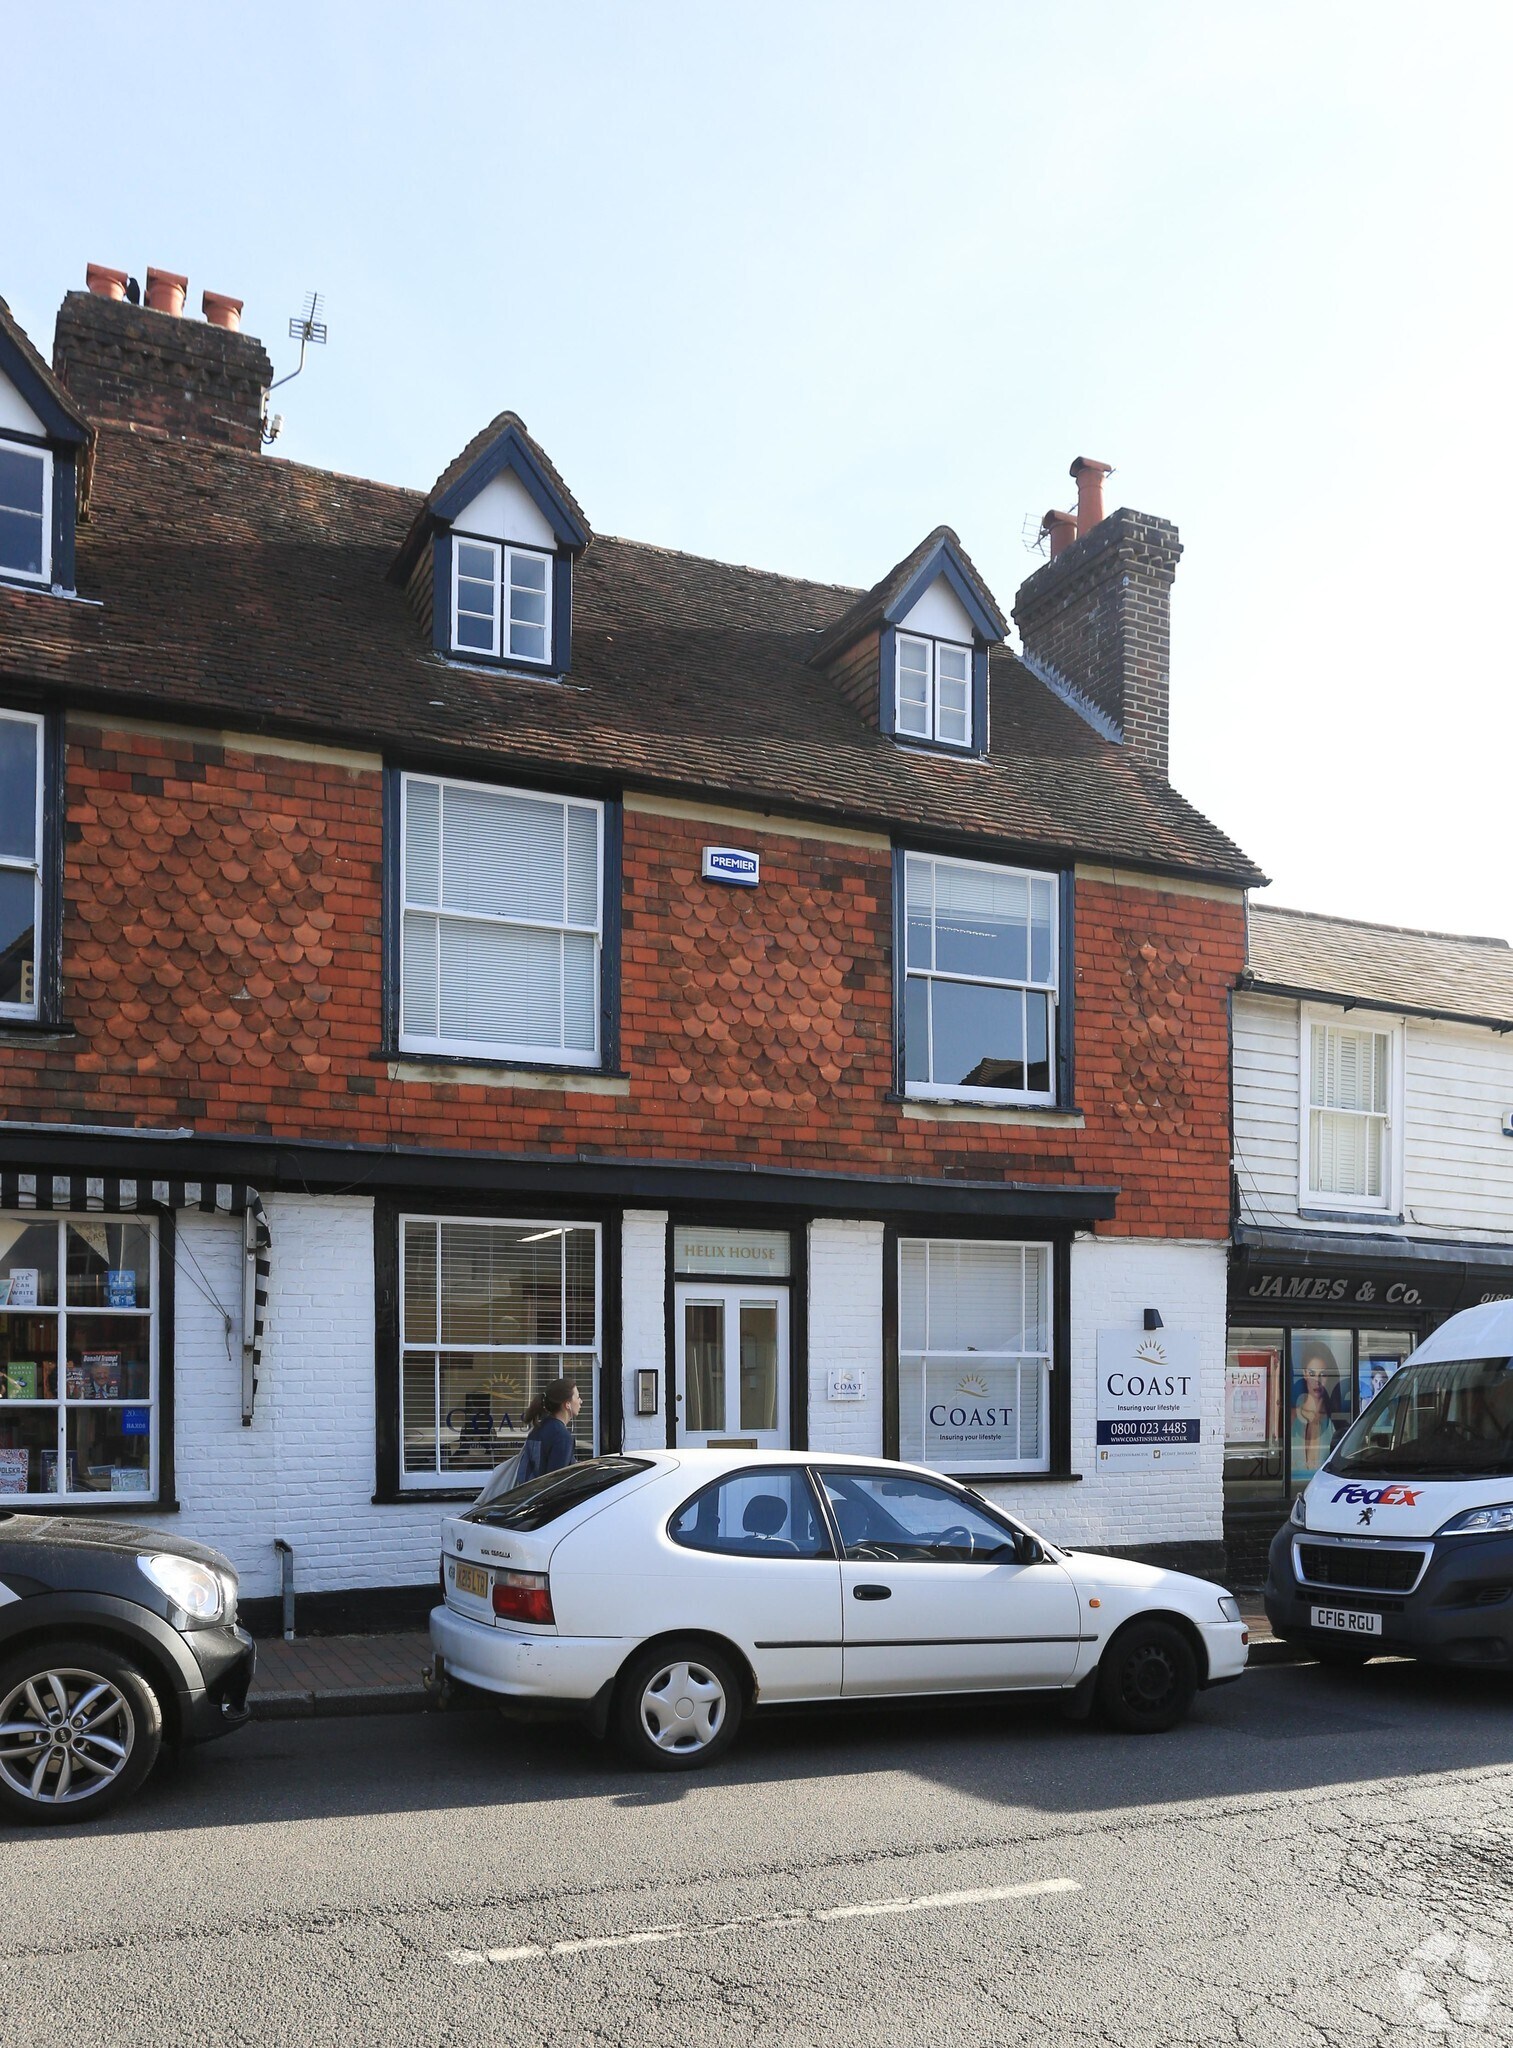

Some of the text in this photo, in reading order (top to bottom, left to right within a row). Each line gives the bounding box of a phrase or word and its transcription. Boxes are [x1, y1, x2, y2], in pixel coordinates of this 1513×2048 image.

[712, 855, 755, 872] PREMIER
[683, 1244, 776, 1260] HELIX HOUSE
[1248, 1275, 1423, 1305] JAMES & Co.
[833, 1382, 862, 1391] COAST
[1107, 1373, 1191, 1396] COAST
[1231, 1372, 1261, 1385] HAIR
[929, 1404, 1013, 1427] COAST
[1117, 1404, 1142, 1412] Insuring
[1157, 1404, 1180, 1412] lifestyle
[446, 1408, 534, 1433] COAS
[1110, 1421, 1187, 1435] 0800 023 4485
[939, 1433, 964, 1442] Insuring
[978, 1433, 1002, 1441] lifestyle
[1330, 1483, 1426, 1507] FedEx
[1317, 1609, 1375, 1632] CF16 RGU
